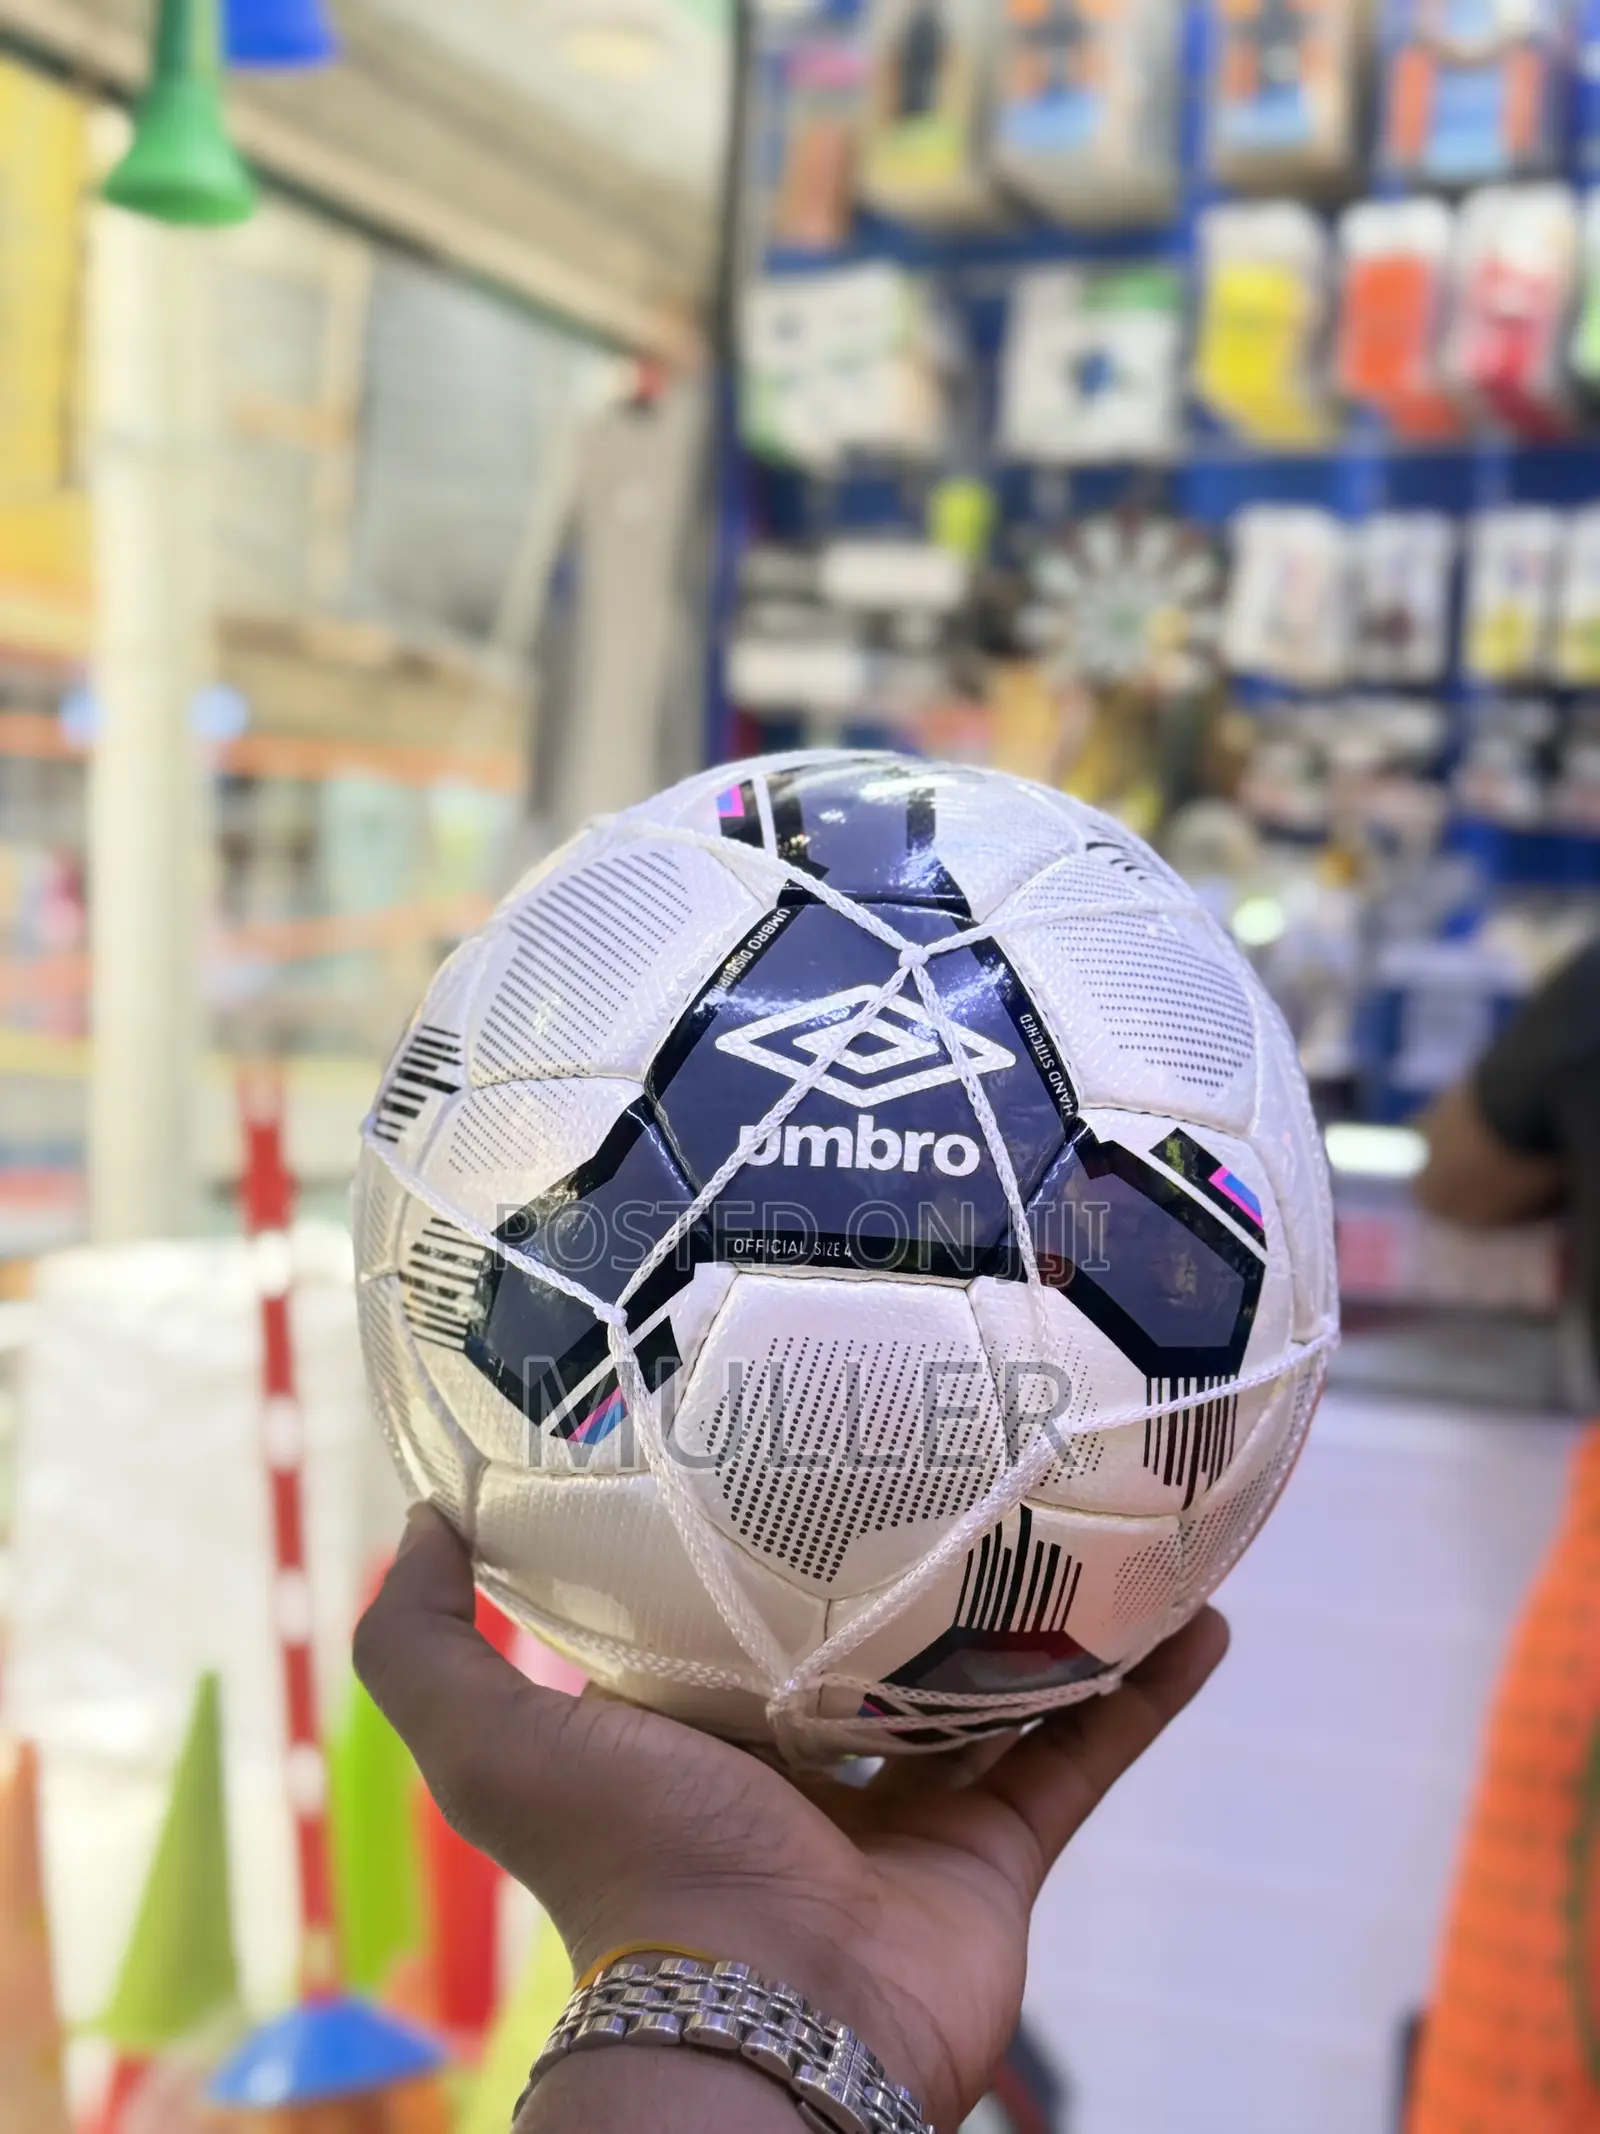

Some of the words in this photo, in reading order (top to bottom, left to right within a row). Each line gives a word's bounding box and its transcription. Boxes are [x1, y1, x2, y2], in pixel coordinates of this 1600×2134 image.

[747, 908, 791, 950] UMBRO
[1020, 1013, 1055, 1069] STITCHED
[1048, 1071, 1074, 1116] HAND
[739, 1114, 981, 1177] umbro
[733, 1238, 808, 1255] OFFICIAL
[813, 1241, 840, 1257] SIZE
[844, 1243, 852, 1258] 4
